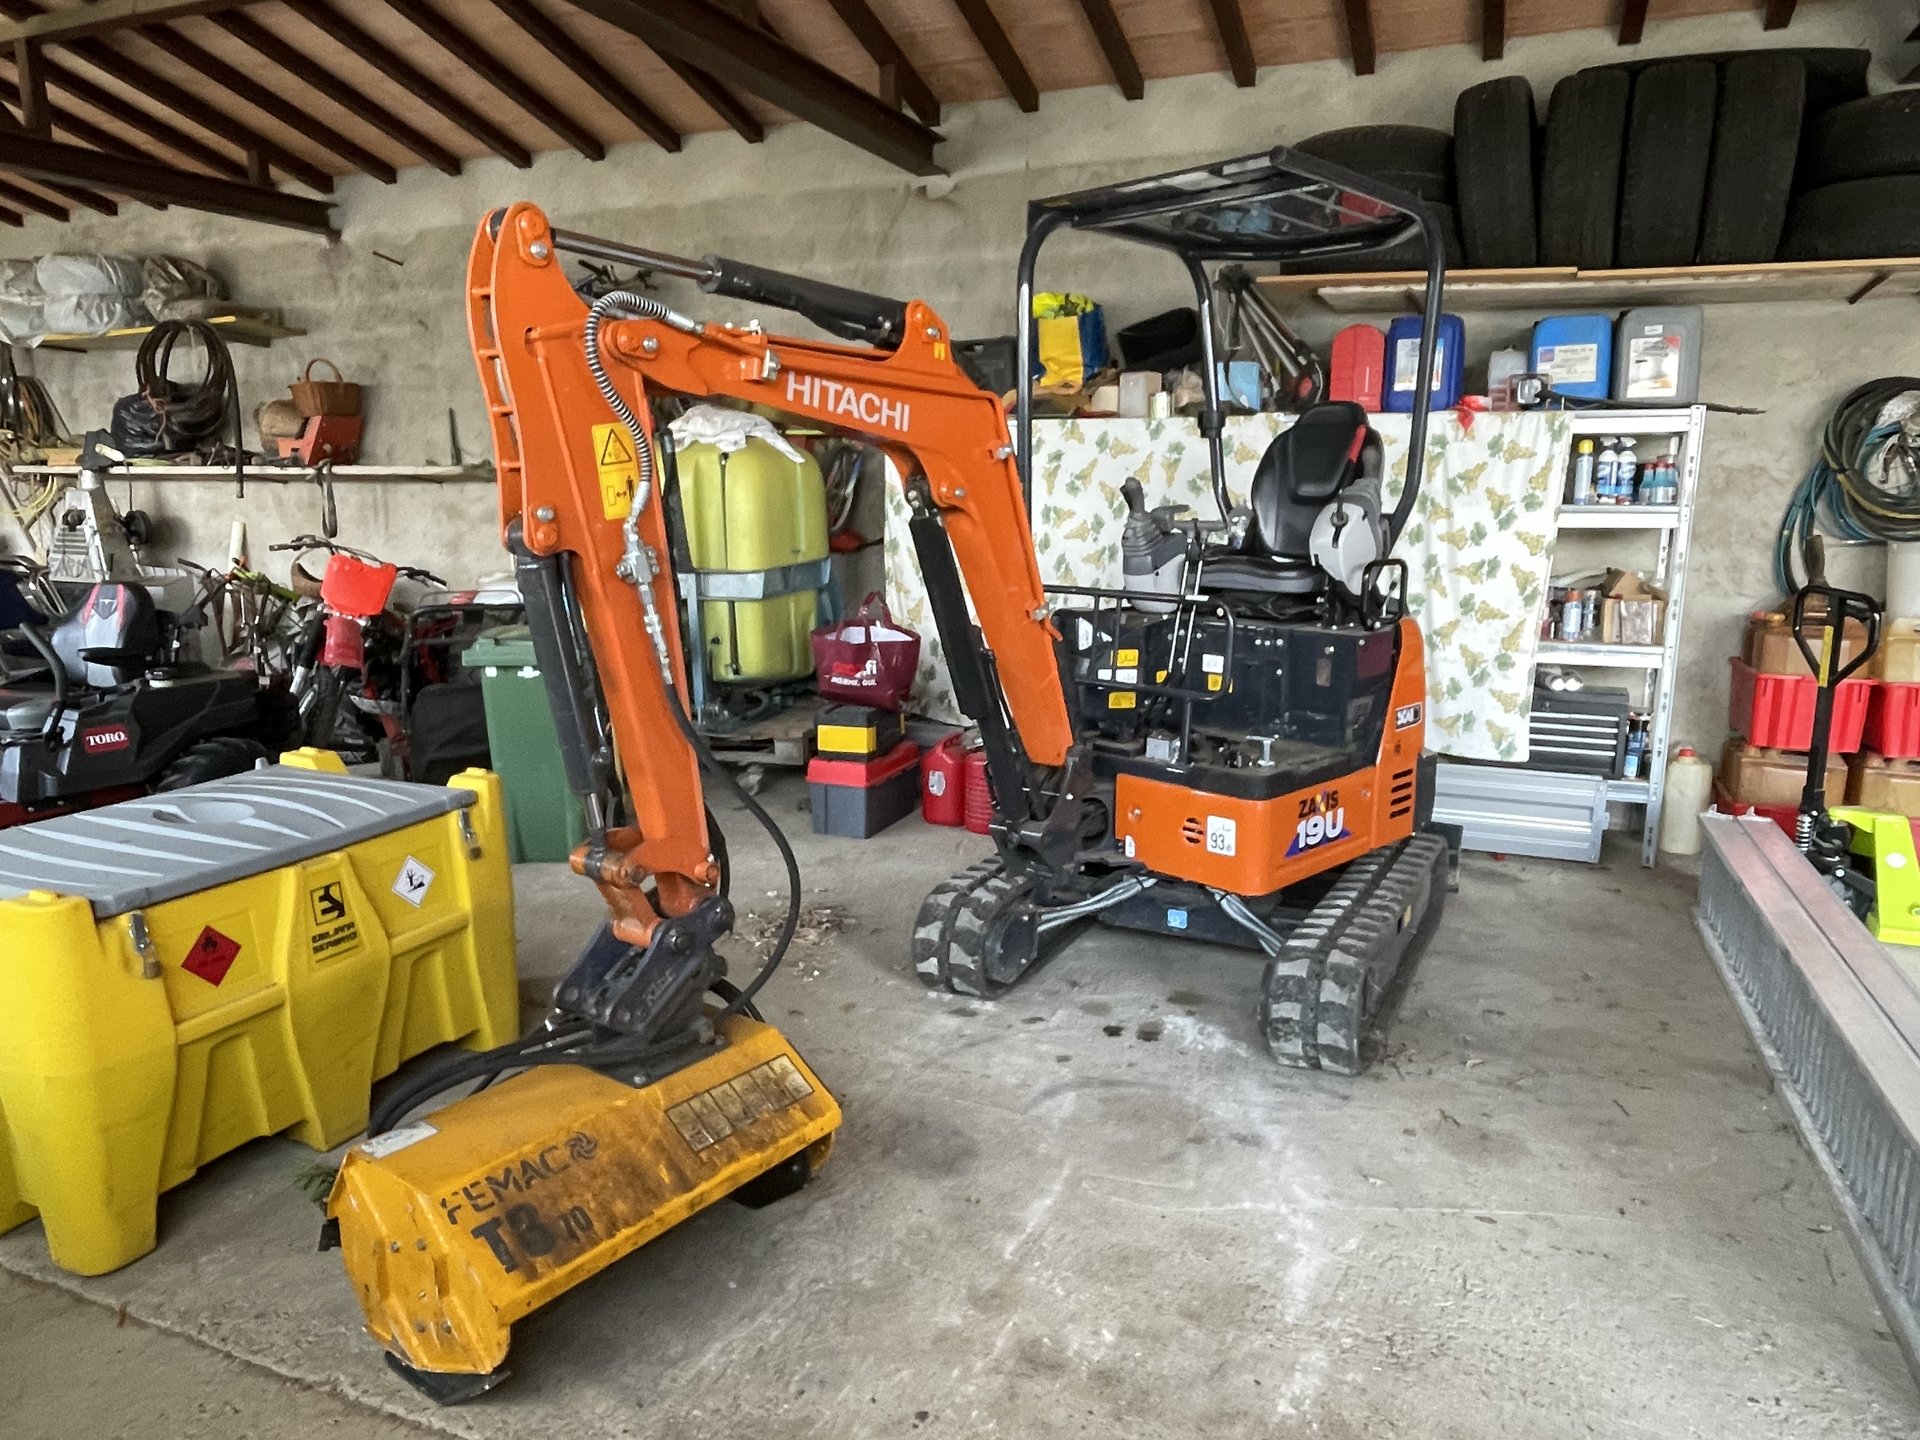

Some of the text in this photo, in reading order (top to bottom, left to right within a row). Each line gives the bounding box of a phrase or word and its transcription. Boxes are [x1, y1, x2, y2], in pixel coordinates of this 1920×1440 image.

[786, 371, 910, 432] HITACHI
[1210, 832, 1225, 851] 93
[1296, 806, 1345, 849] 19U
